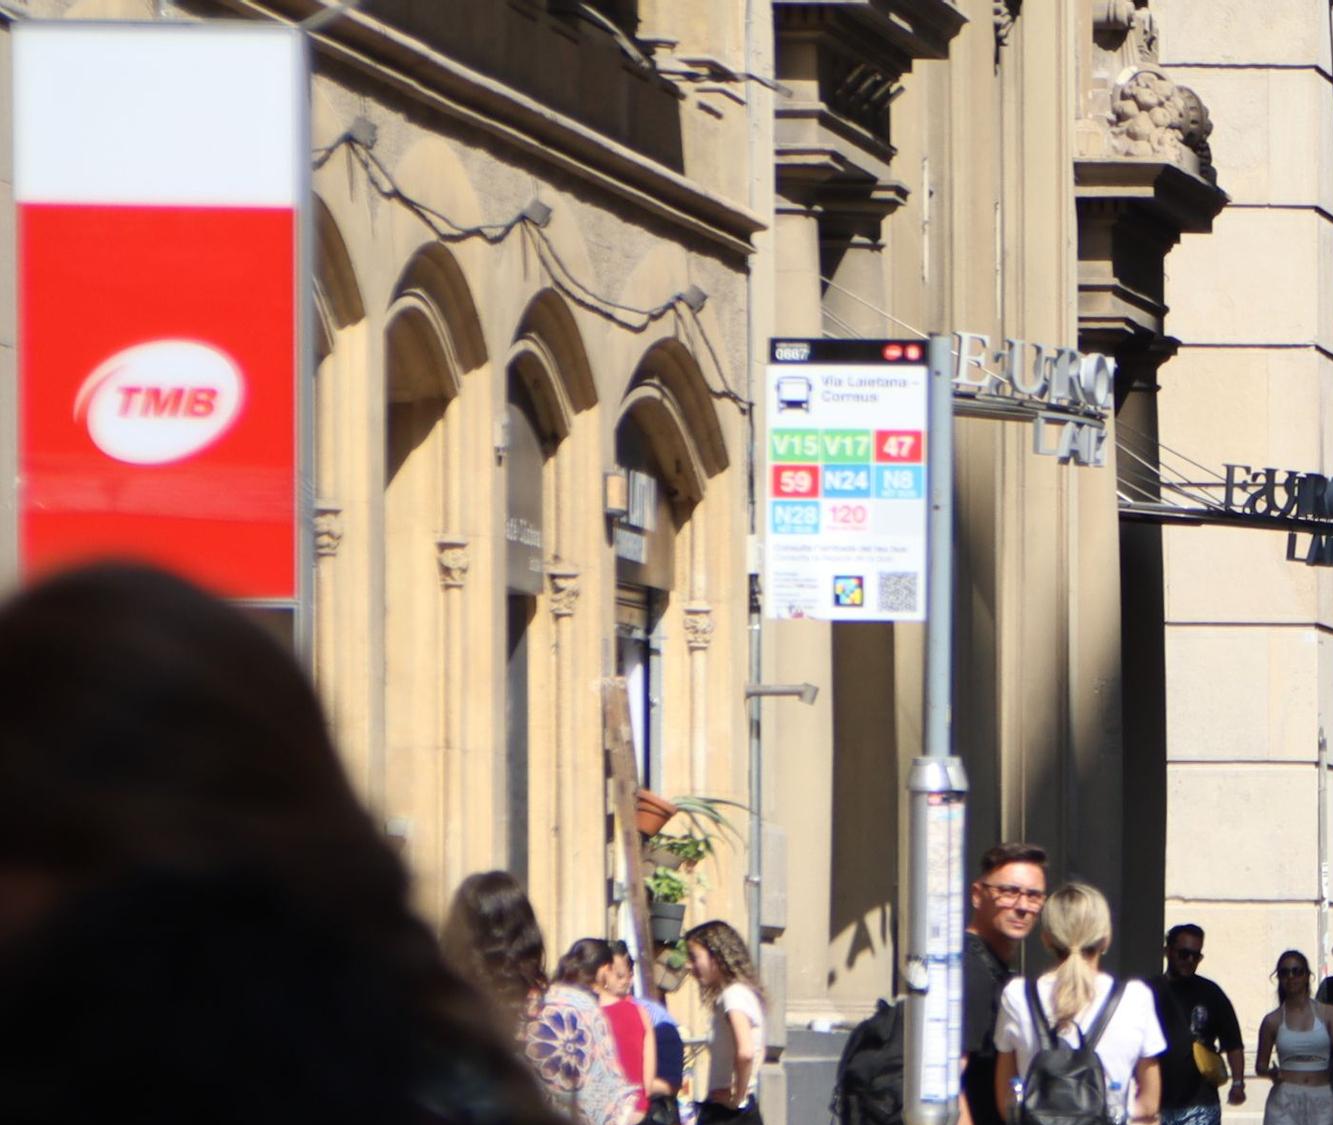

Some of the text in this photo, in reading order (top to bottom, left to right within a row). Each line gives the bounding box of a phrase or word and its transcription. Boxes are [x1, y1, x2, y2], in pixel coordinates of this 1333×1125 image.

[821, 376, 842, 387] Via
[117, 386, 218, 418] TMB
[772, 434, 818, 456] V15
[823, 434, 870, 456] V17
[882, 435, 915, 457] 47
[779, 471, 812, 493] 59
[825, 471, 868, 490] N24
[883, 470, 913, 490] N8
[774, 505, 817, 524] N28
[830, 505, 867, 524] 120
